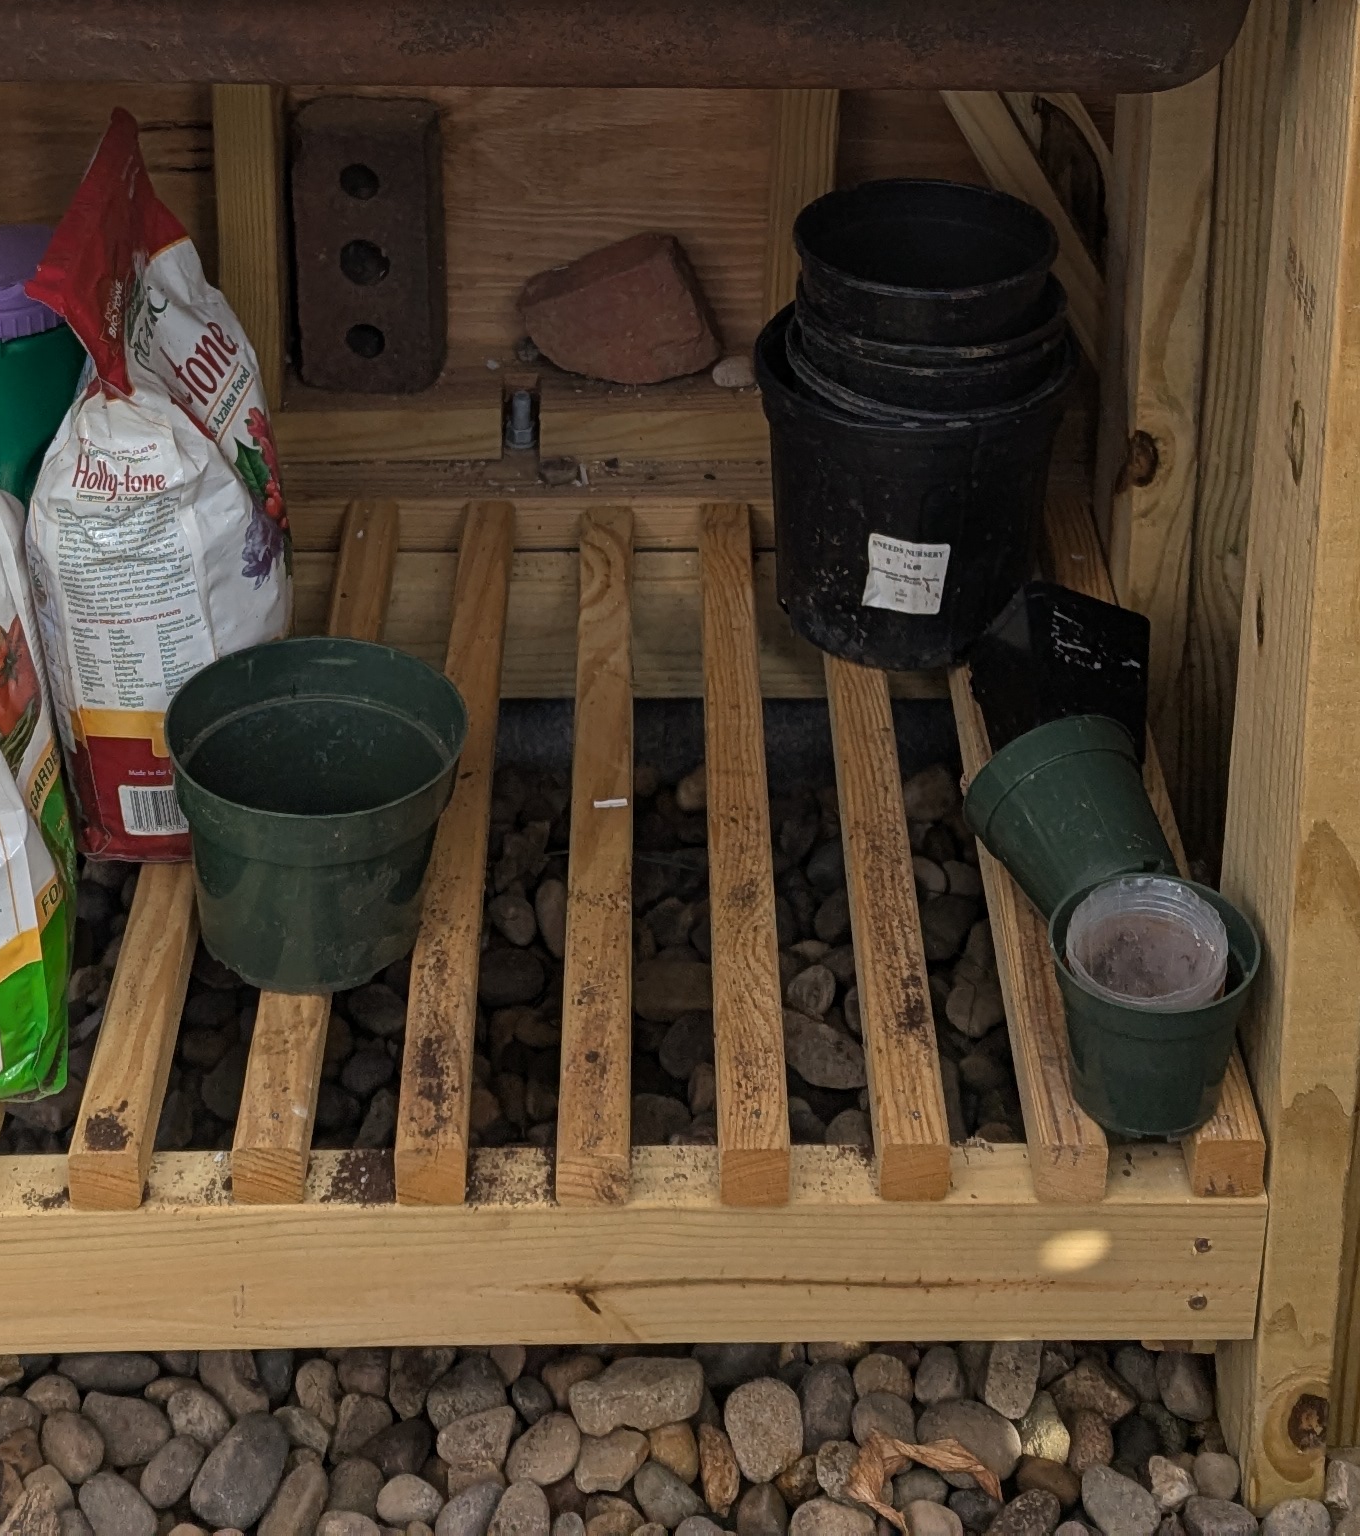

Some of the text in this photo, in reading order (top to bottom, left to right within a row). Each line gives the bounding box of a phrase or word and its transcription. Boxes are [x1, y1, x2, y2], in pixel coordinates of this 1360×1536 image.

[213, 392, 238, 430] Azalea
[231, 364, 251, 395] Food
[71, 453, 167, 502] Holly-tone
[76, 492, 105, 502] Evergreen
[104, 505, 131, 513] 4-3-4
[872, 539, 945, 559] SNEEDS NURSERY
[116, 617, 133, 625] ACID
[158, 608, 182, 620] PLANTS
